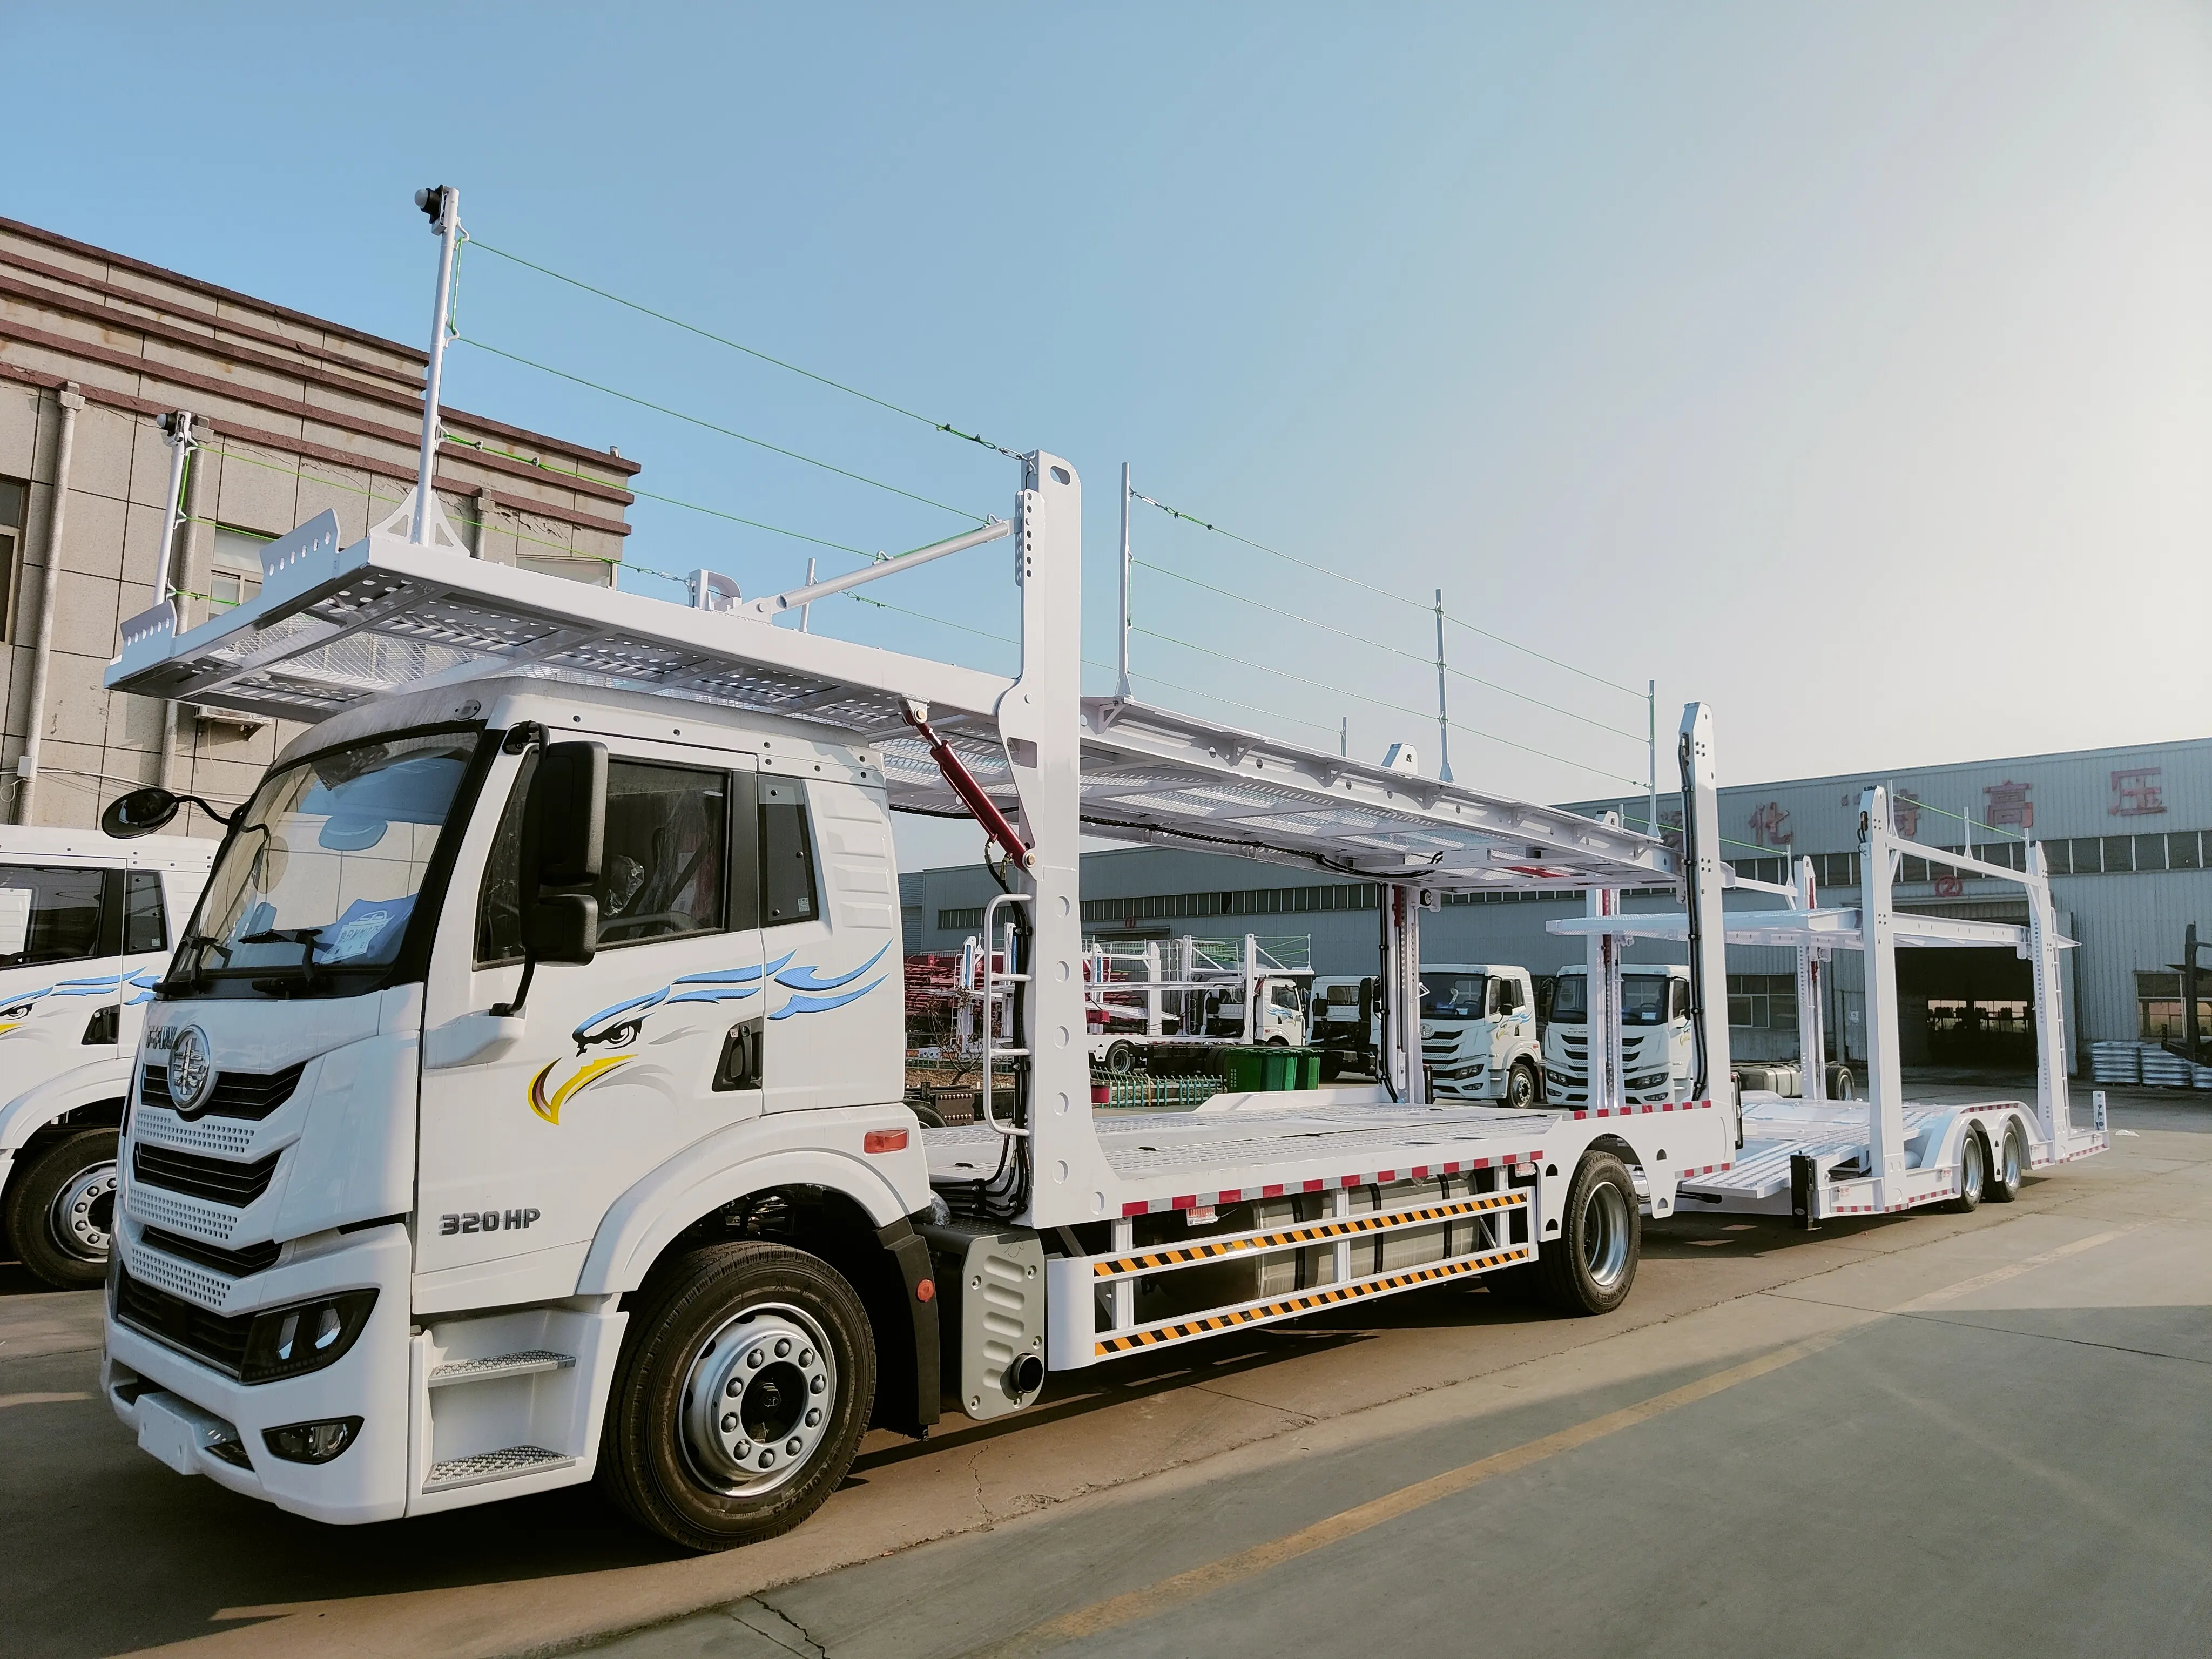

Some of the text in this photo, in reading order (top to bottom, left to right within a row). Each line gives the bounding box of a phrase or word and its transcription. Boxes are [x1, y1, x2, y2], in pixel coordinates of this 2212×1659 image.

[146, 1026, 178, 1049] FAW
[438, 1208, 541, 1236] 320 HP
